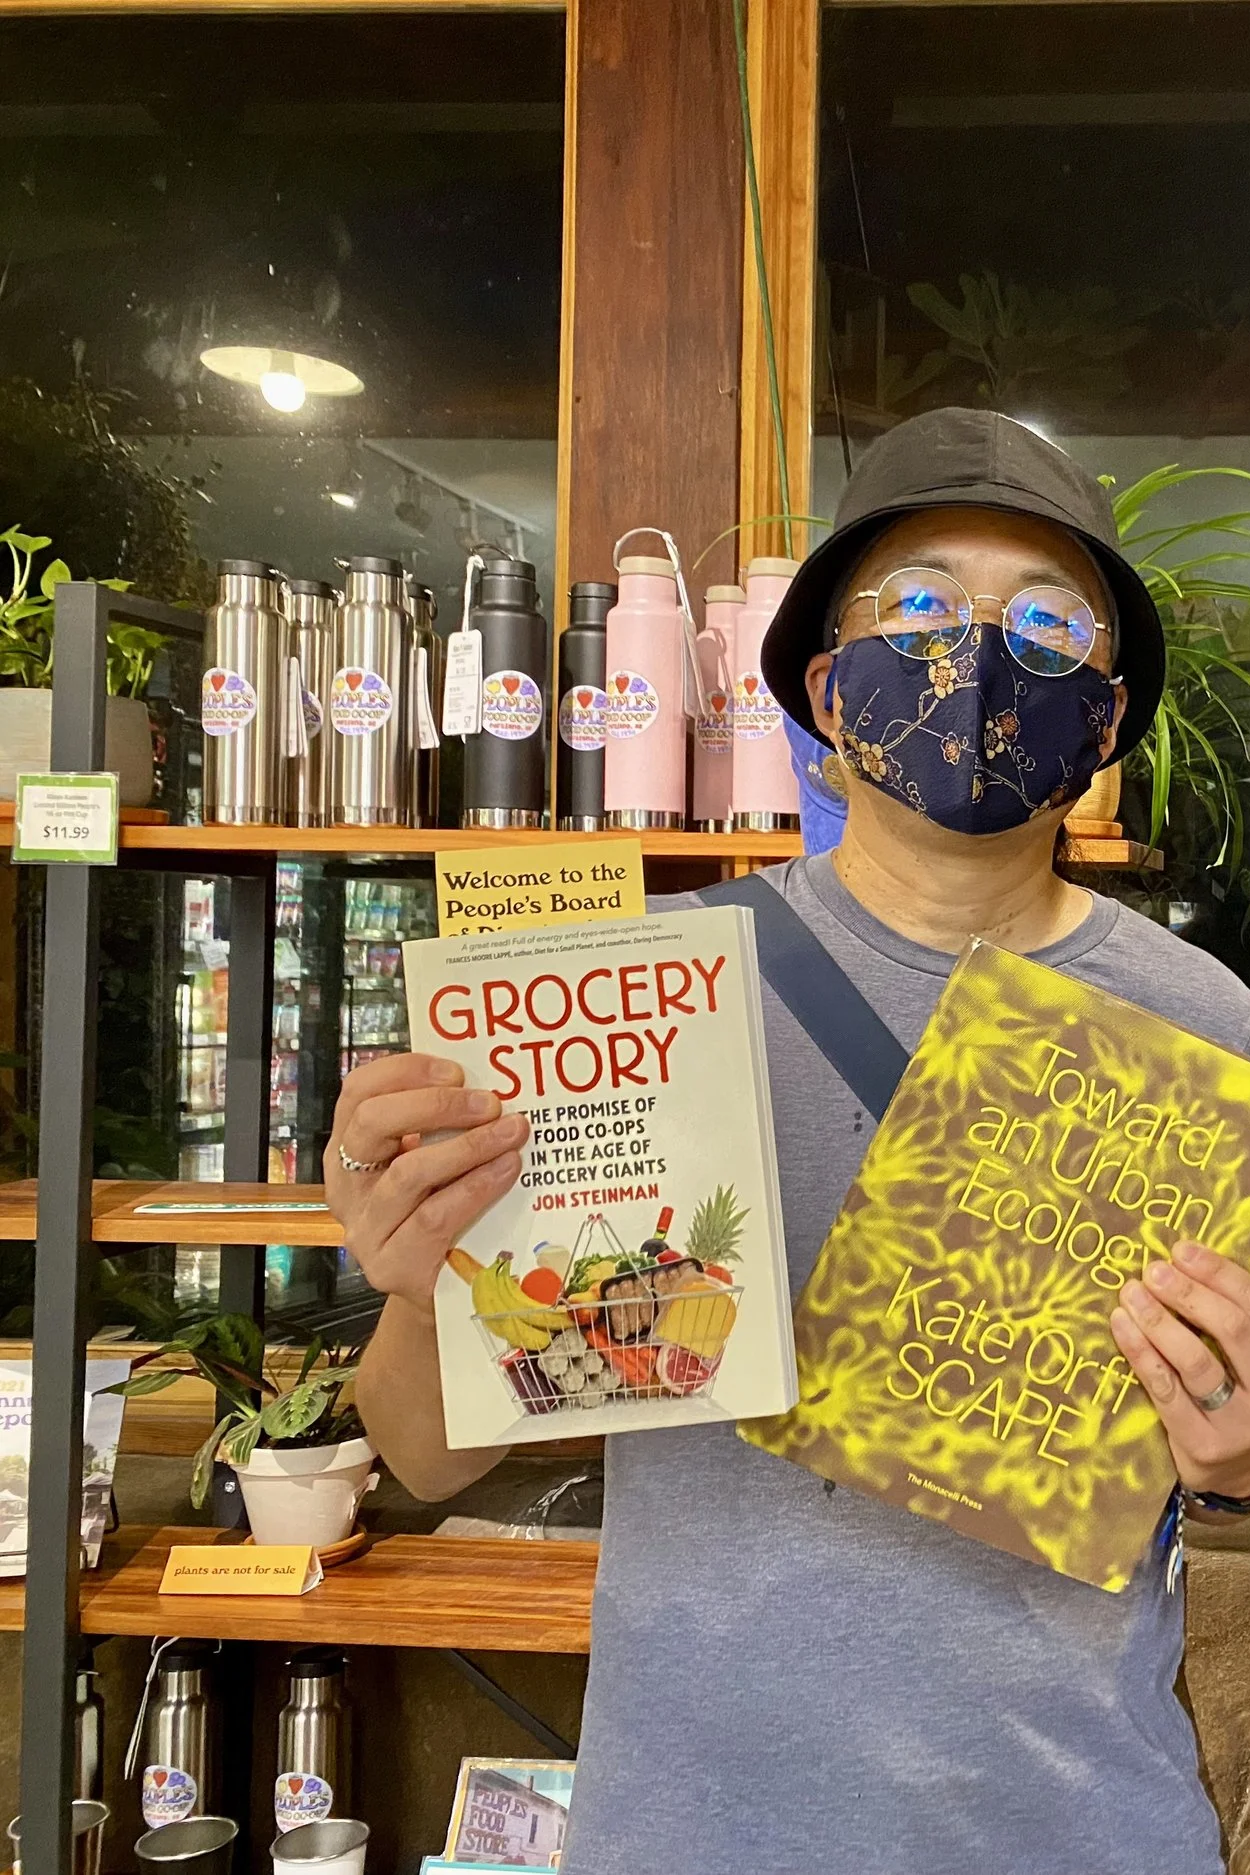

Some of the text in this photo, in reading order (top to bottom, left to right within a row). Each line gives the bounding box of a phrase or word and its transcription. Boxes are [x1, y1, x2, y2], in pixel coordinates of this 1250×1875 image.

[43, 825, 90, 839] $11.99
[442, 863, 627, 891] Welcome to the
[445, 890, 622, 919] People's Board
[445, 956, 471, 965] FRANCES
[471, 953, 493, 962] MOORE
[534, 947, 546, 955] Diet
[559, 944, 575, 952] Small
[575, 942, 595, 951] Planet,
[595, 940, 606, 948] and
[633, 936, 652, 944] Daring
[652, 933, 683, 942] Democracy
[461, 943, 468, 952] A
[469, 941, 490, 952] great
[512, 937, 526, 945] Full
[536, 934, 562, 943] energy
[564, 931, 579, 940] and
[580, 925, 640, 940] eyes-wide-open
[641, 923, 662, 933] hope.
[428, 955, 726, 1041] GROCERY
[488, 1026, 678, 1100] STORY
[556, 1101, 631, 1121] PROMISE
[636, 1097, 657, 1113] OF
[1033, 1039, 1226, 1170] Toward
[534, 1119, 646, 1145] FOOD CO-OPS
[530, 1139, 652, 1166] IN THE AGE OF
[520, 1158, 667, 1188] GROCERY GIANTS
[967, 1106, 1215, 1238] an Urban
[532, 1183, 660, 1212] JON STEINMAN
[957, 1159, 1148, 1290] Ecolog
[885, 1265, 1138, 1414] Kate Orff
[886, 1342, 1086, 1468] SCAPE
[907, 1472, 982, 1511] The Monacelli Press
[174, 1565, 296, 1577] plants are not for sale
[469, 1804, 506, 1833] FOOD
[463, 1828, 510, 1856] STORE
